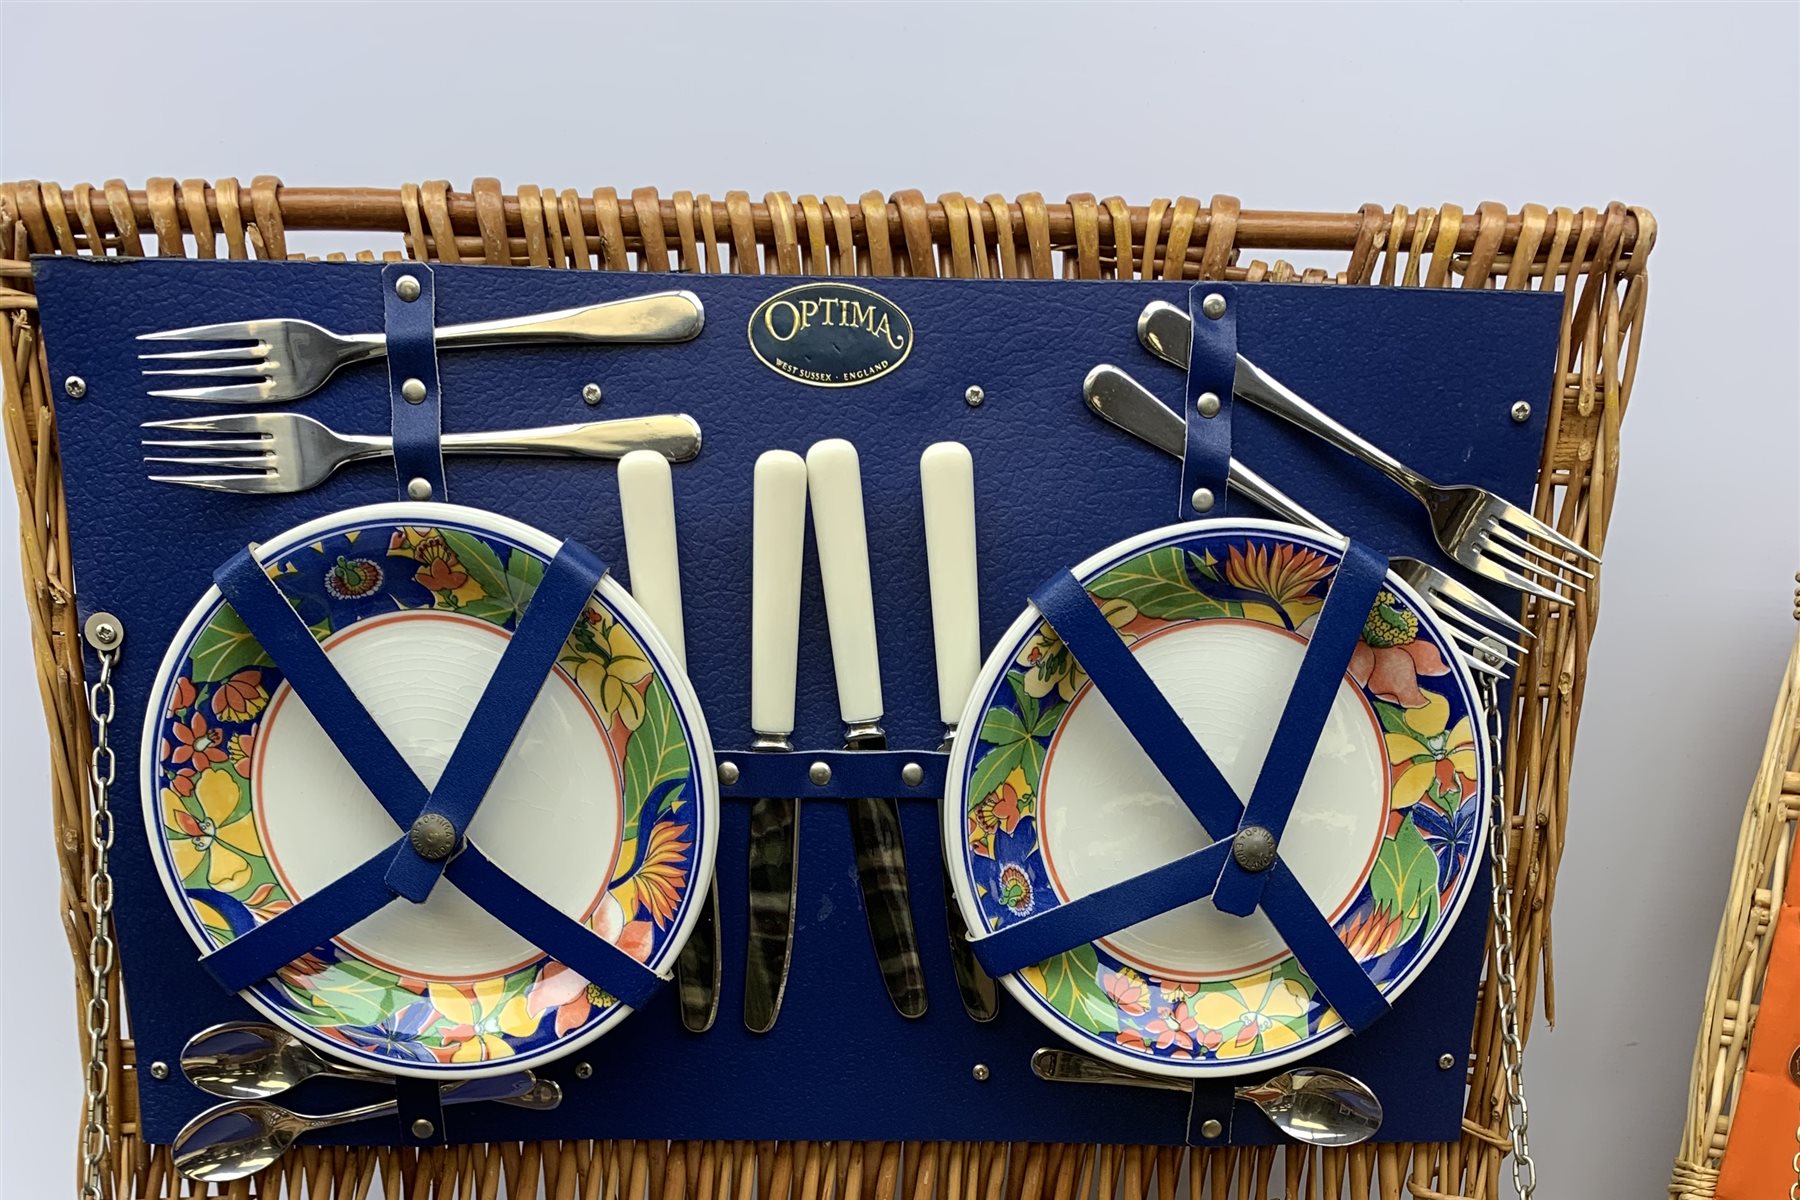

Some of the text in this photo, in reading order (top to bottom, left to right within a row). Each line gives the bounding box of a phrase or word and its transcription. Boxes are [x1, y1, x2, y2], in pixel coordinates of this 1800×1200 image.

[764, 297, 904, 350] OPTIMA
[774, 357, 889, 382] WEST SUSSEX ENGLAND
